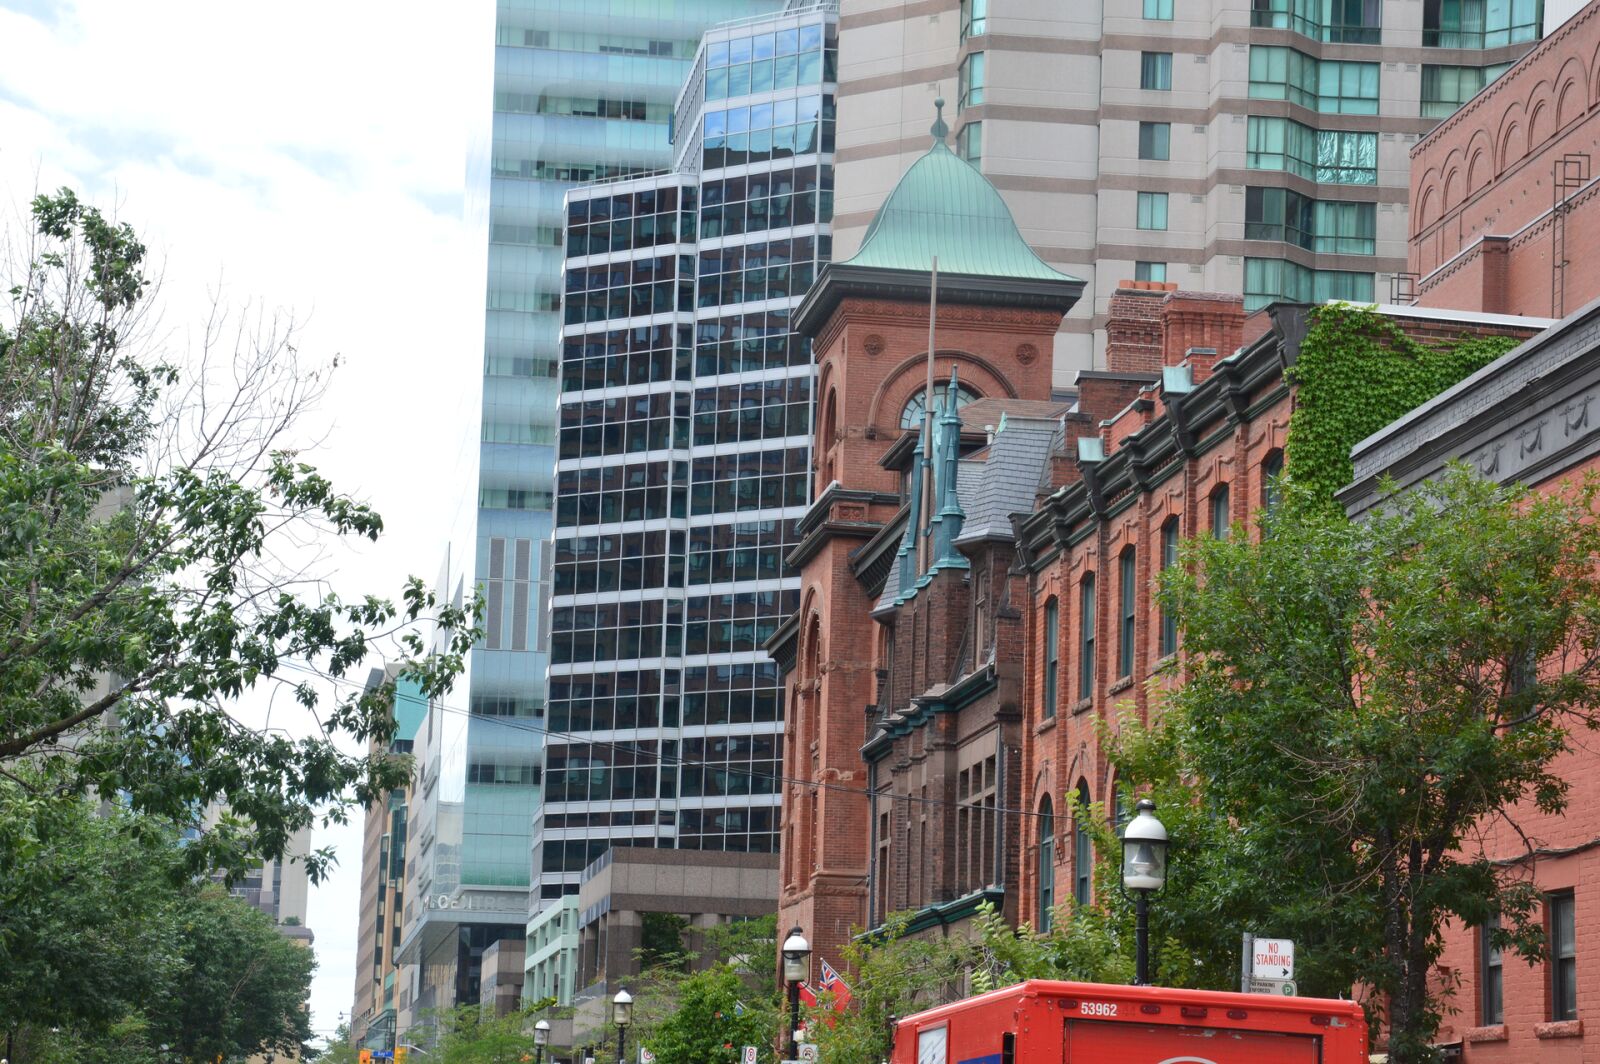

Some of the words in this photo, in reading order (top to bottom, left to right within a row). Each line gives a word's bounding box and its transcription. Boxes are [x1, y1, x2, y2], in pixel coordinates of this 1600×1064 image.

[1268, 943, 1279, 954] NO
[1256, 954, 1291, 966] STANDING
[1081, 1002, 1117, 1016] 53962
